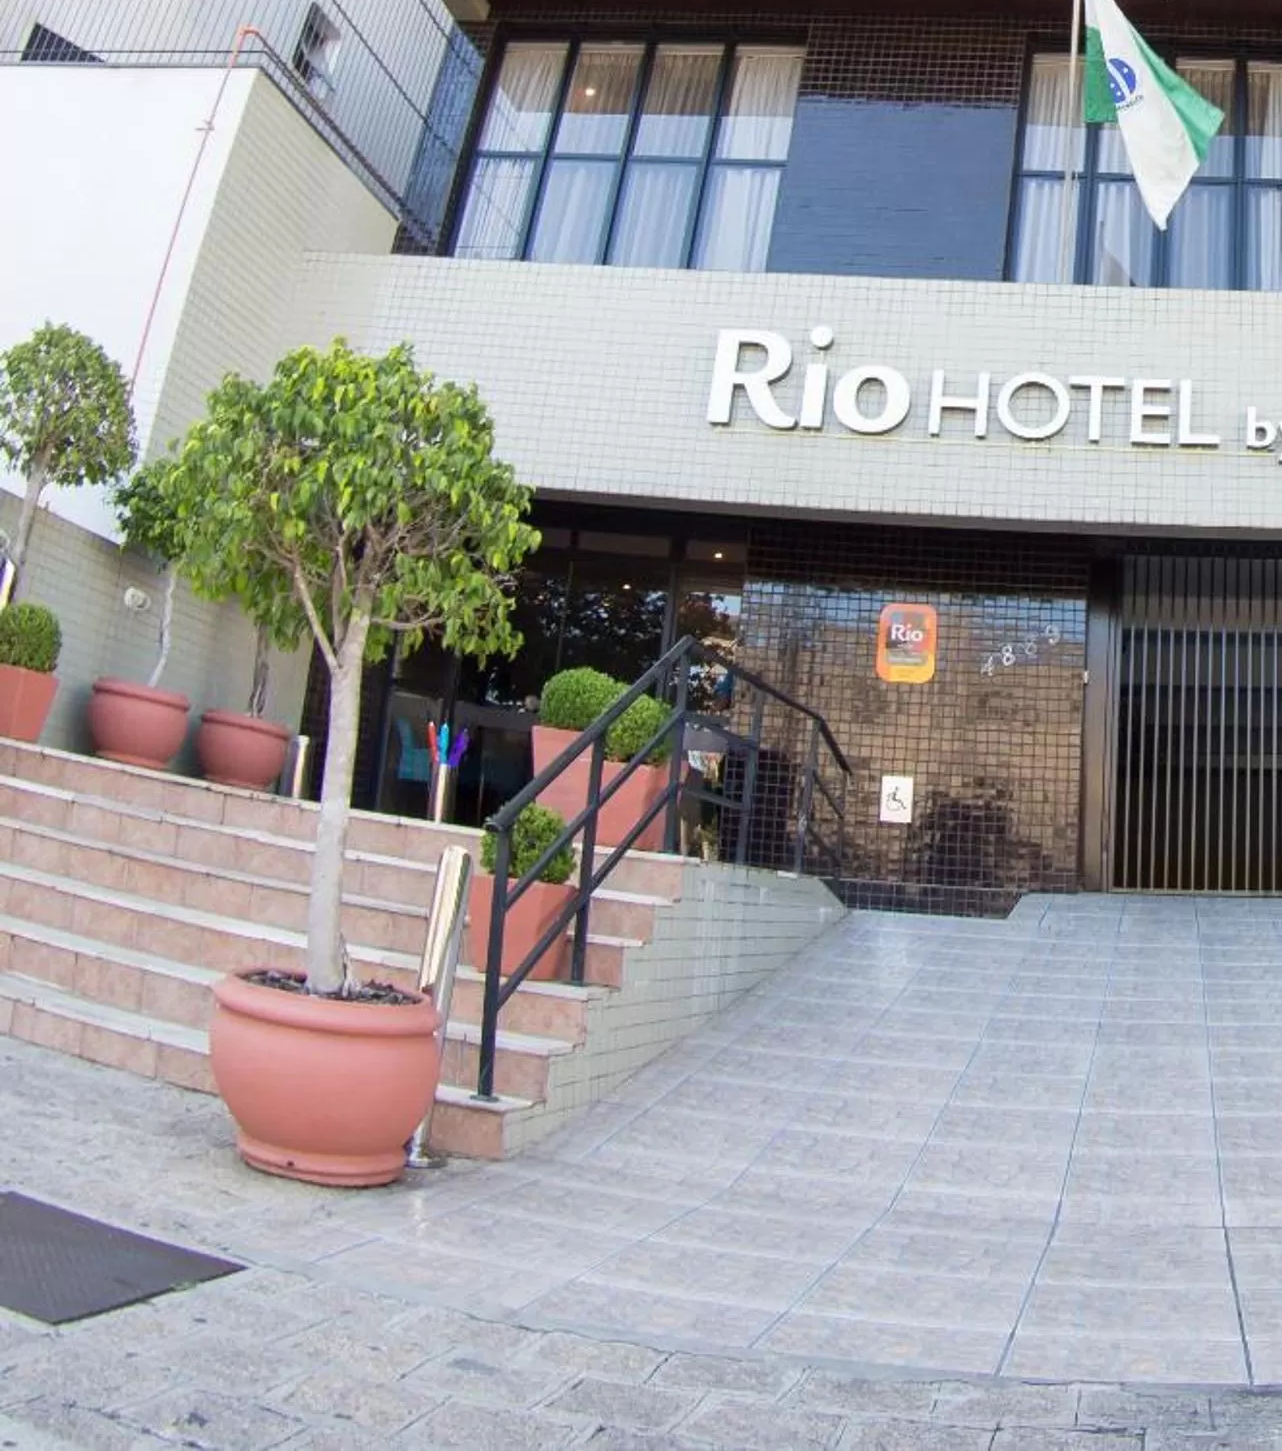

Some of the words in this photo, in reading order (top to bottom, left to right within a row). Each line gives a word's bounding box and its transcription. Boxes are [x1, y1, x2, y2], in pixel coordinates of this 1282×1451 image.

[707, 326, 910, 434] Rio
[928, 369, 1221, 446] HOTEL
[891, 623, 923, 642] Rio
